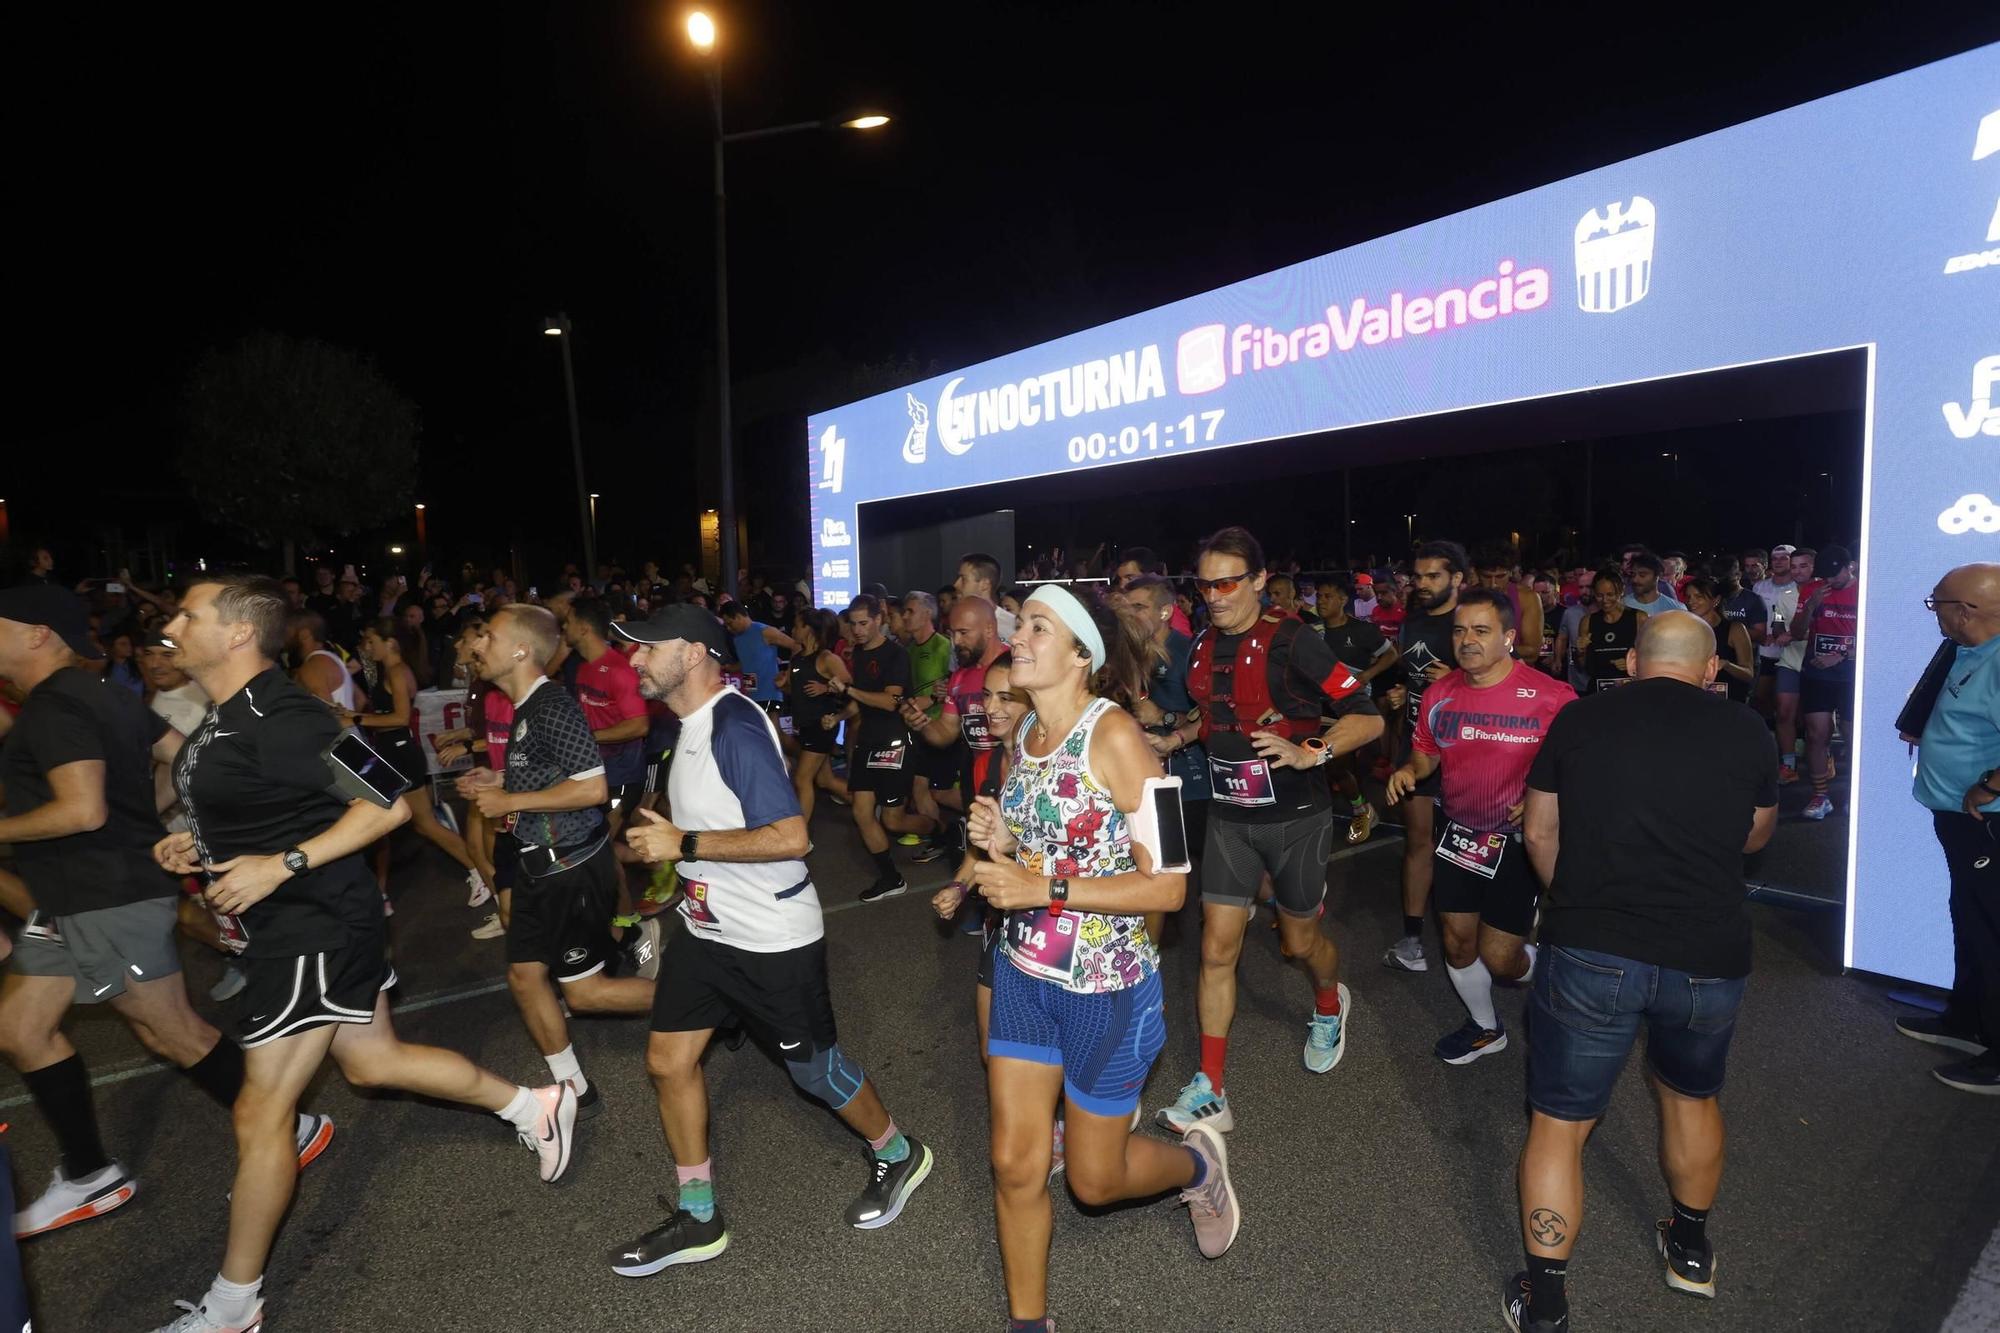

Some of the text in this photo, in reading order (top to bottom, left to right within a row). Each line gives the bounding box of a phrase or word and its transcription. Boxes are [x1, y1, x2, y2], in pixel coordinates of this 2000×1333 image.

[979, 344, 1167, 437] NOCTURNA
[1068, 409, 1225, 464] 00:01:17
[1461, 713, 1541, 731] NOCTURNA
[1225, 778, 1249, 791] 111
[1452, 834, 1489, 858] 2624
[1017, 921, 1047, 951] 114
